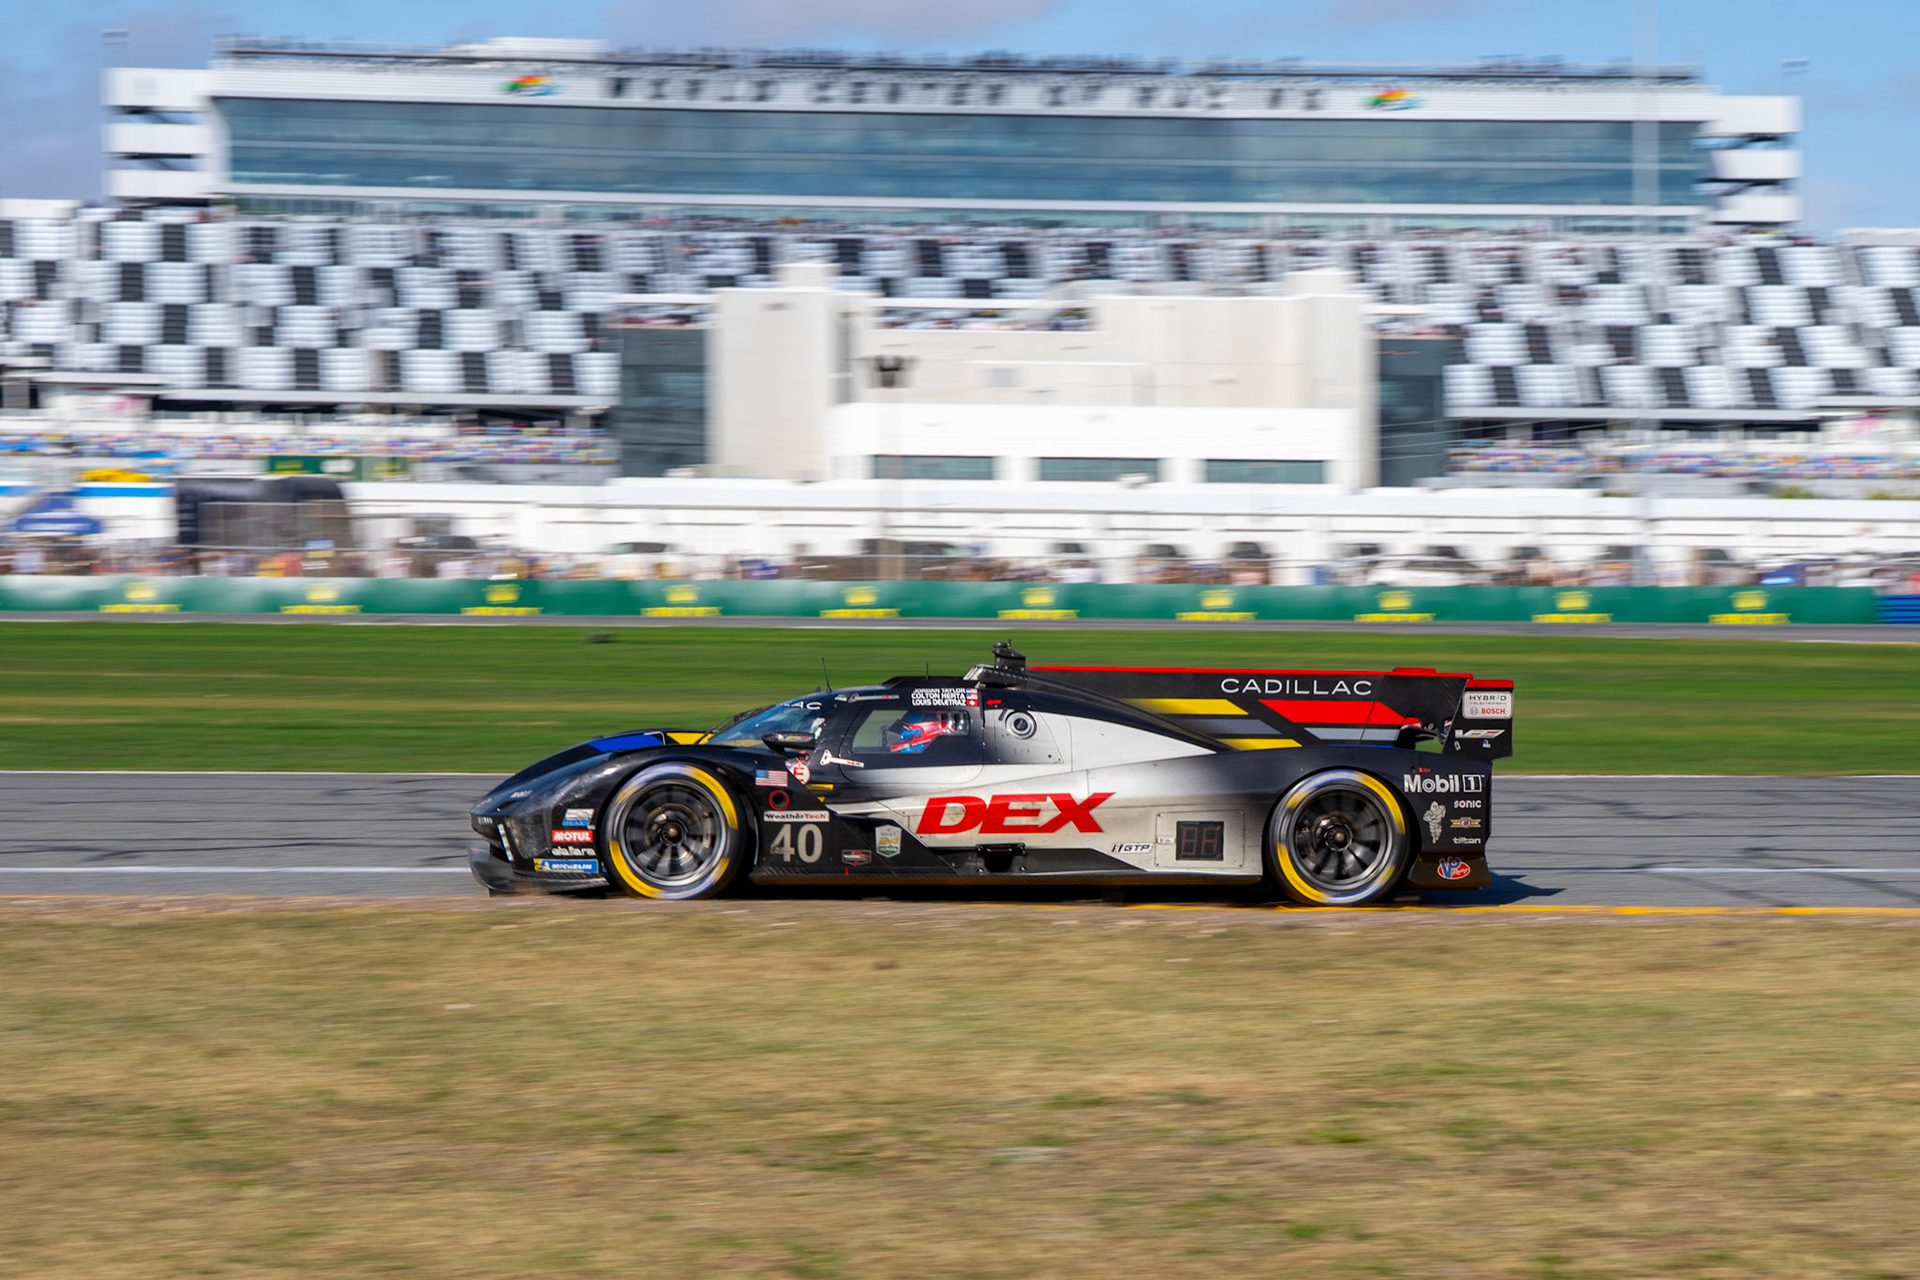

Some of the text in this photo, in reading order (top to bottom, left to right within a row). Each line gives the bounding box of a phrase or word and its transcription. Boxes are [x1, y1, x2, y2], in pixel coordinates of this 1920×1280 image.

[1220, 678, 1372, 696] CADILLAC
[1404, 774, 1460, 793] Mobil
[764, 812, 827, 820] WeatherTech
[916, 793, 1116, 835] DEX
[554, 832, 591, 841] MOTUL
[769, 823, 823, 863] 40
[1123, 844, 1151, 852] GTP
[1438, 857, 1461, 879] VP
